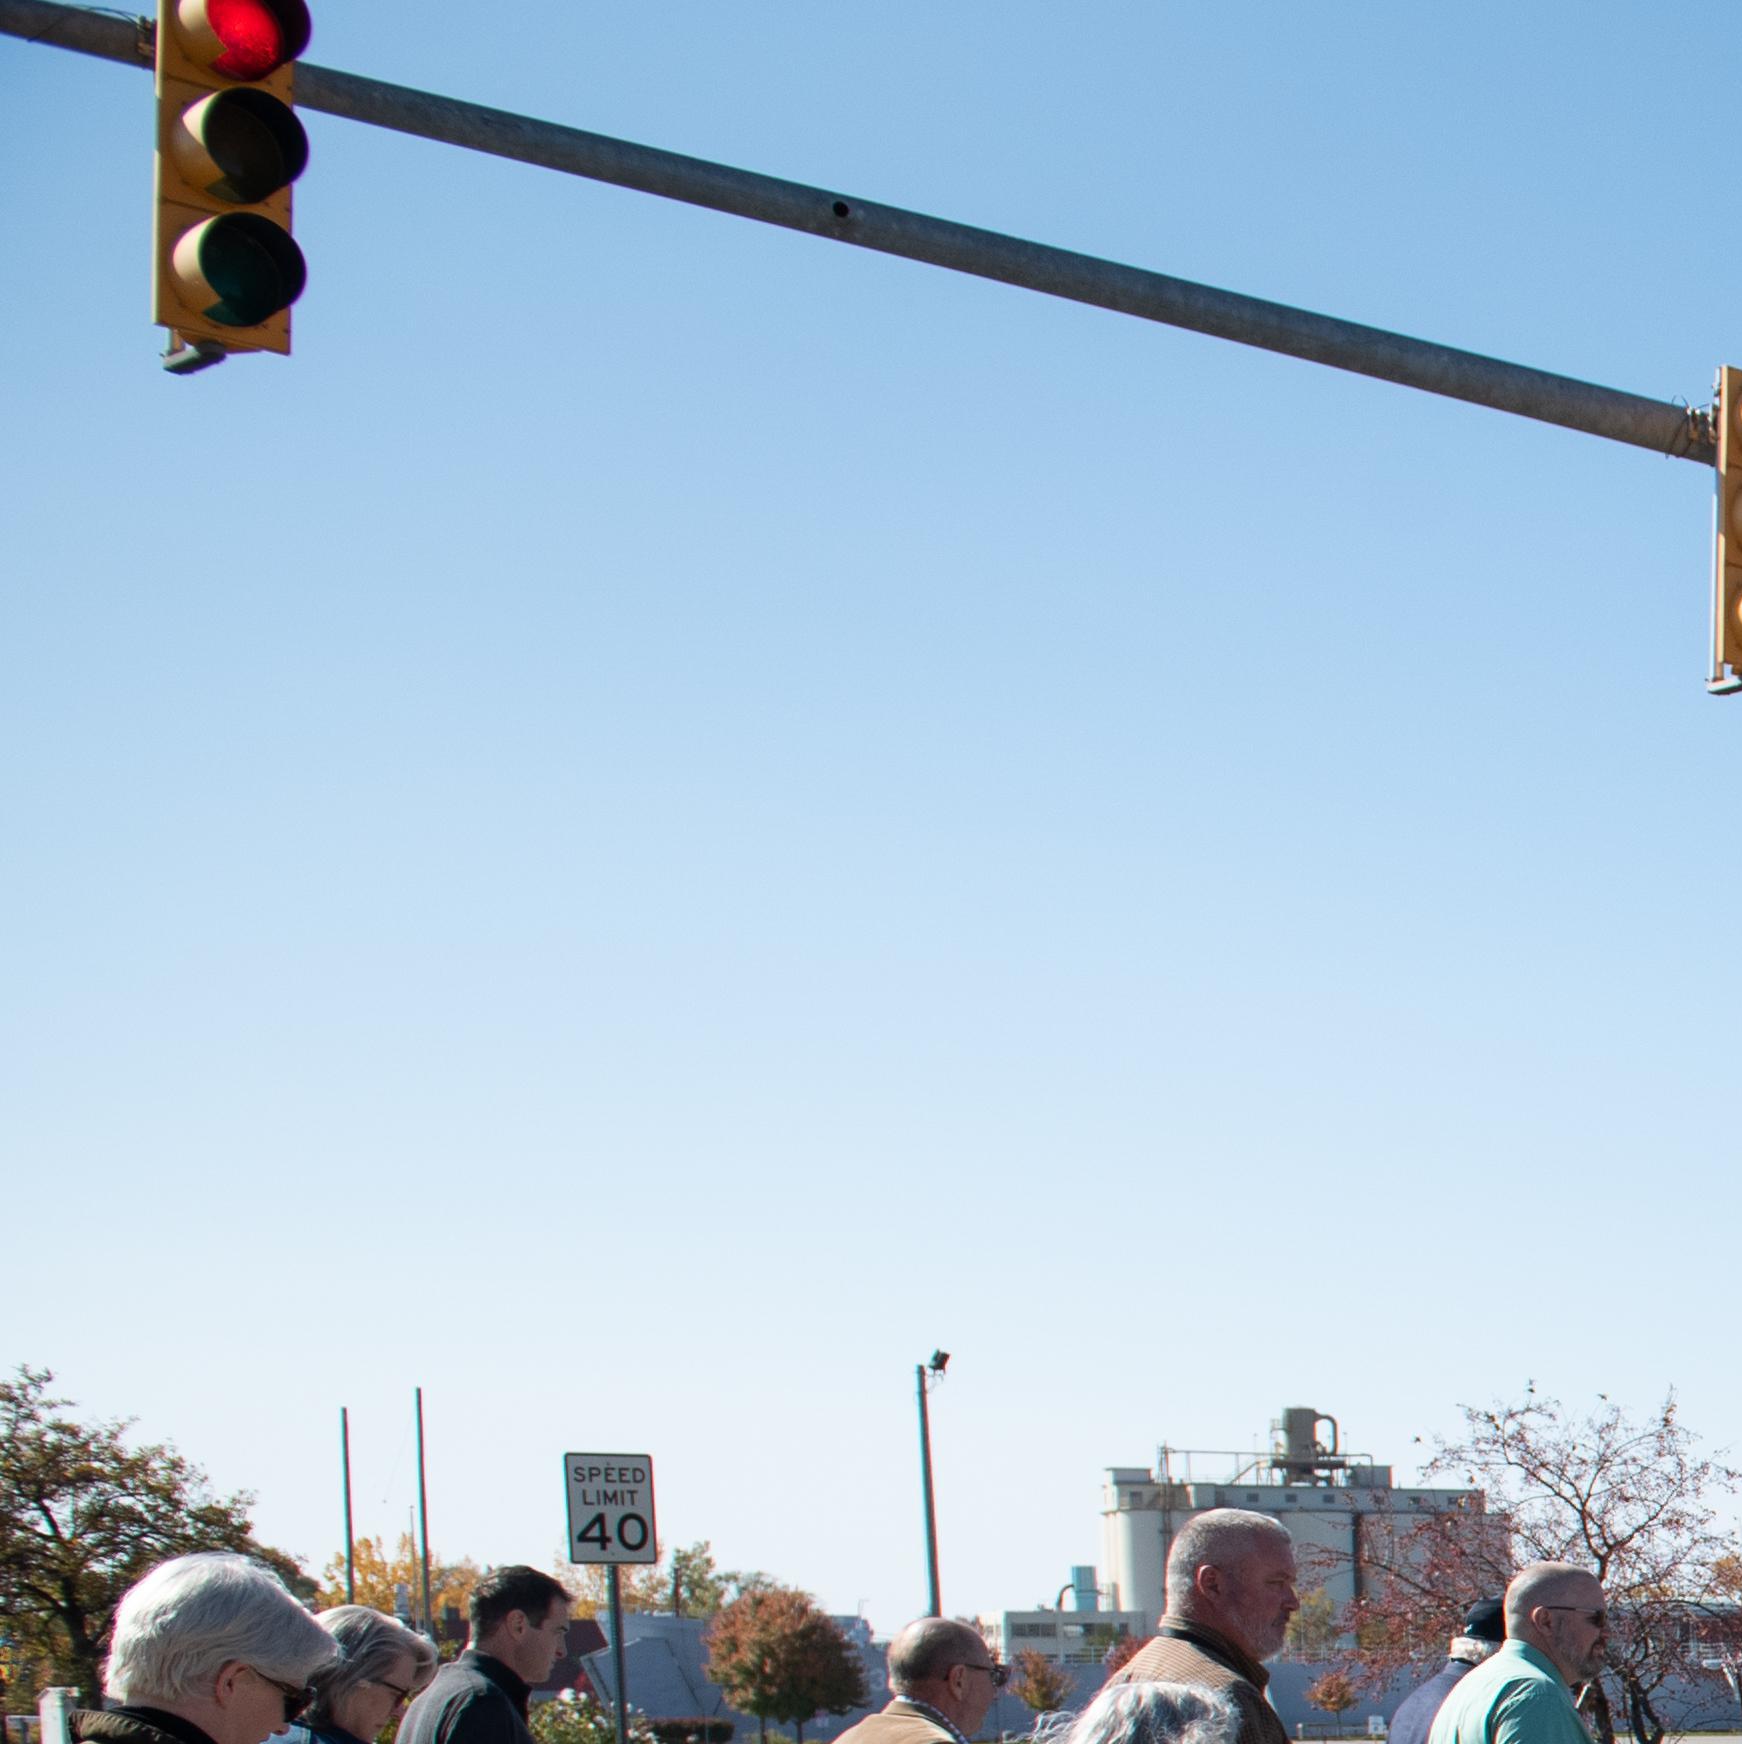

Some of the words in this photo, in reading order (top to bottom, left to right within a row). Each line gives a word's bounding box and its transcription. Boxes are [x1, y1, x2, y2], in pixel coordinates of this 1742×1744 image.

[573, 1466, 646, 1484] SPEED
[582, 1489, 639, 1506] LIMIT
[576, 1512, 649, 1551] 40
